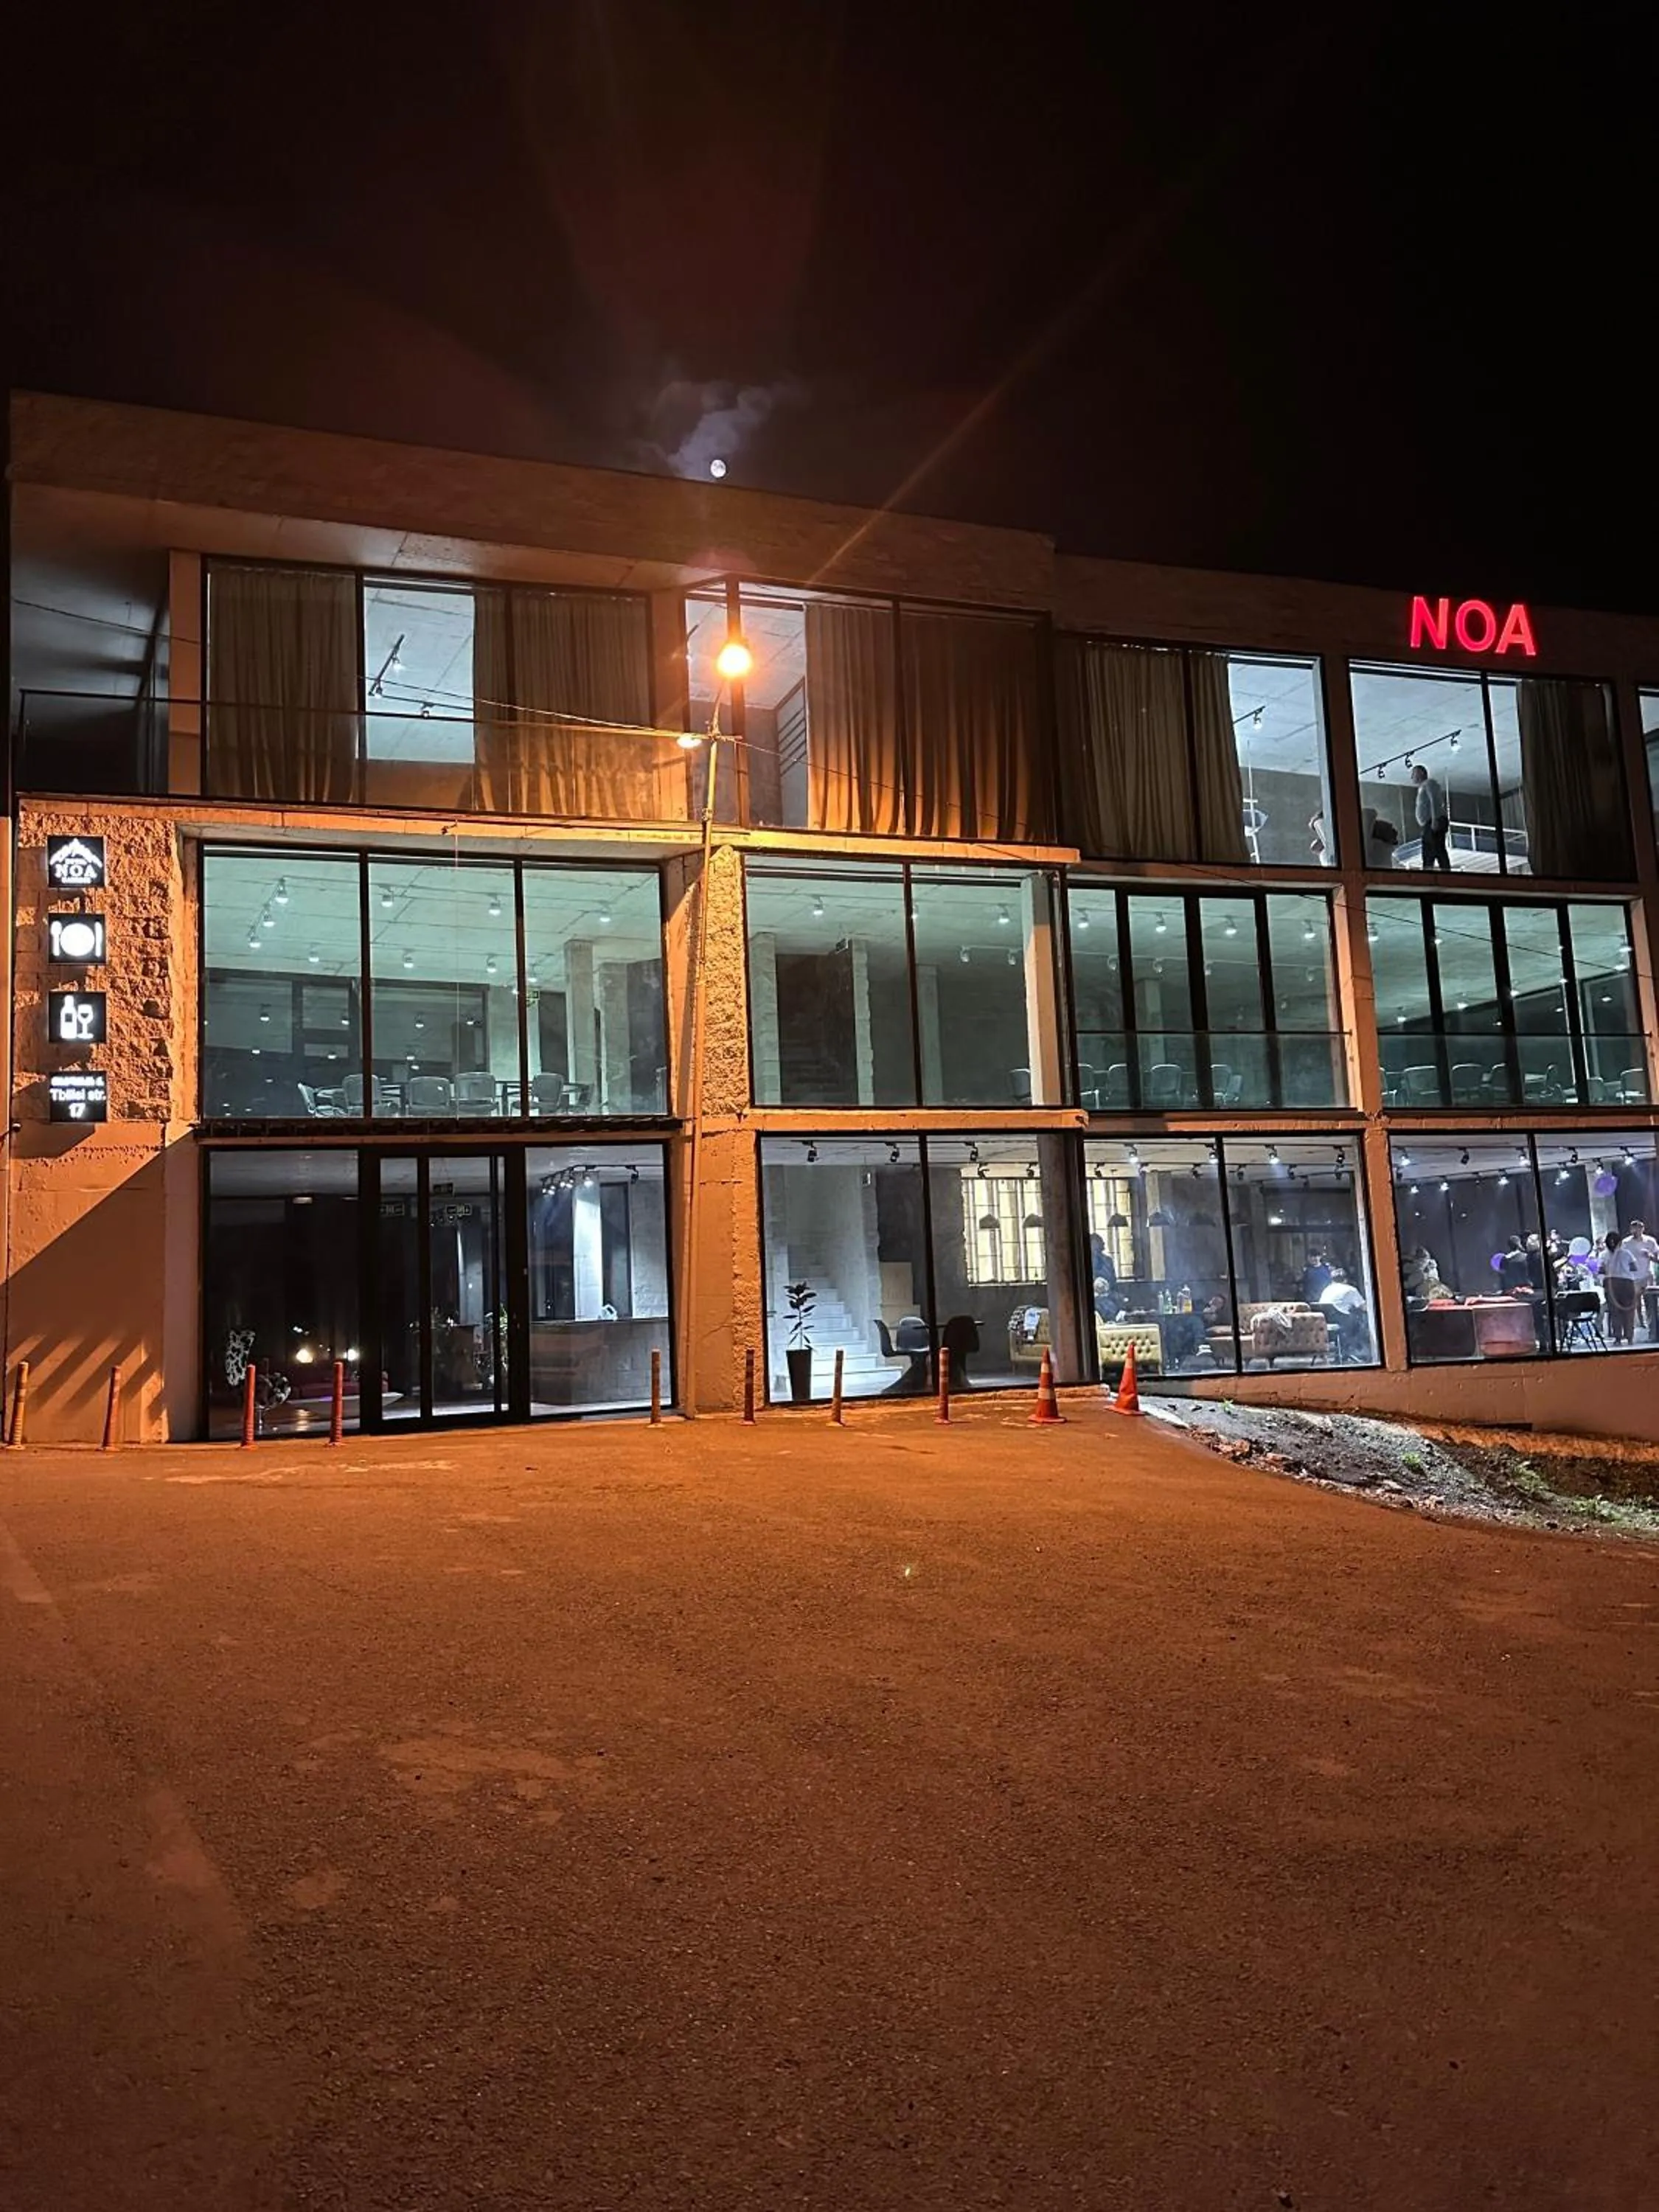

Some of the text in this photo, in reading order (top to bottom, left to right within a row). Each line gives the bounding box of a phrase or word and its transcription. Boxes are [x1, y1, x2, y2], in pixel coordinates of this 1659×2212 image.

[1410, 596, 1537, 656] NOA
[55, 863, 97, 879] NOA
[69, 1102, 86, 1118] 17
